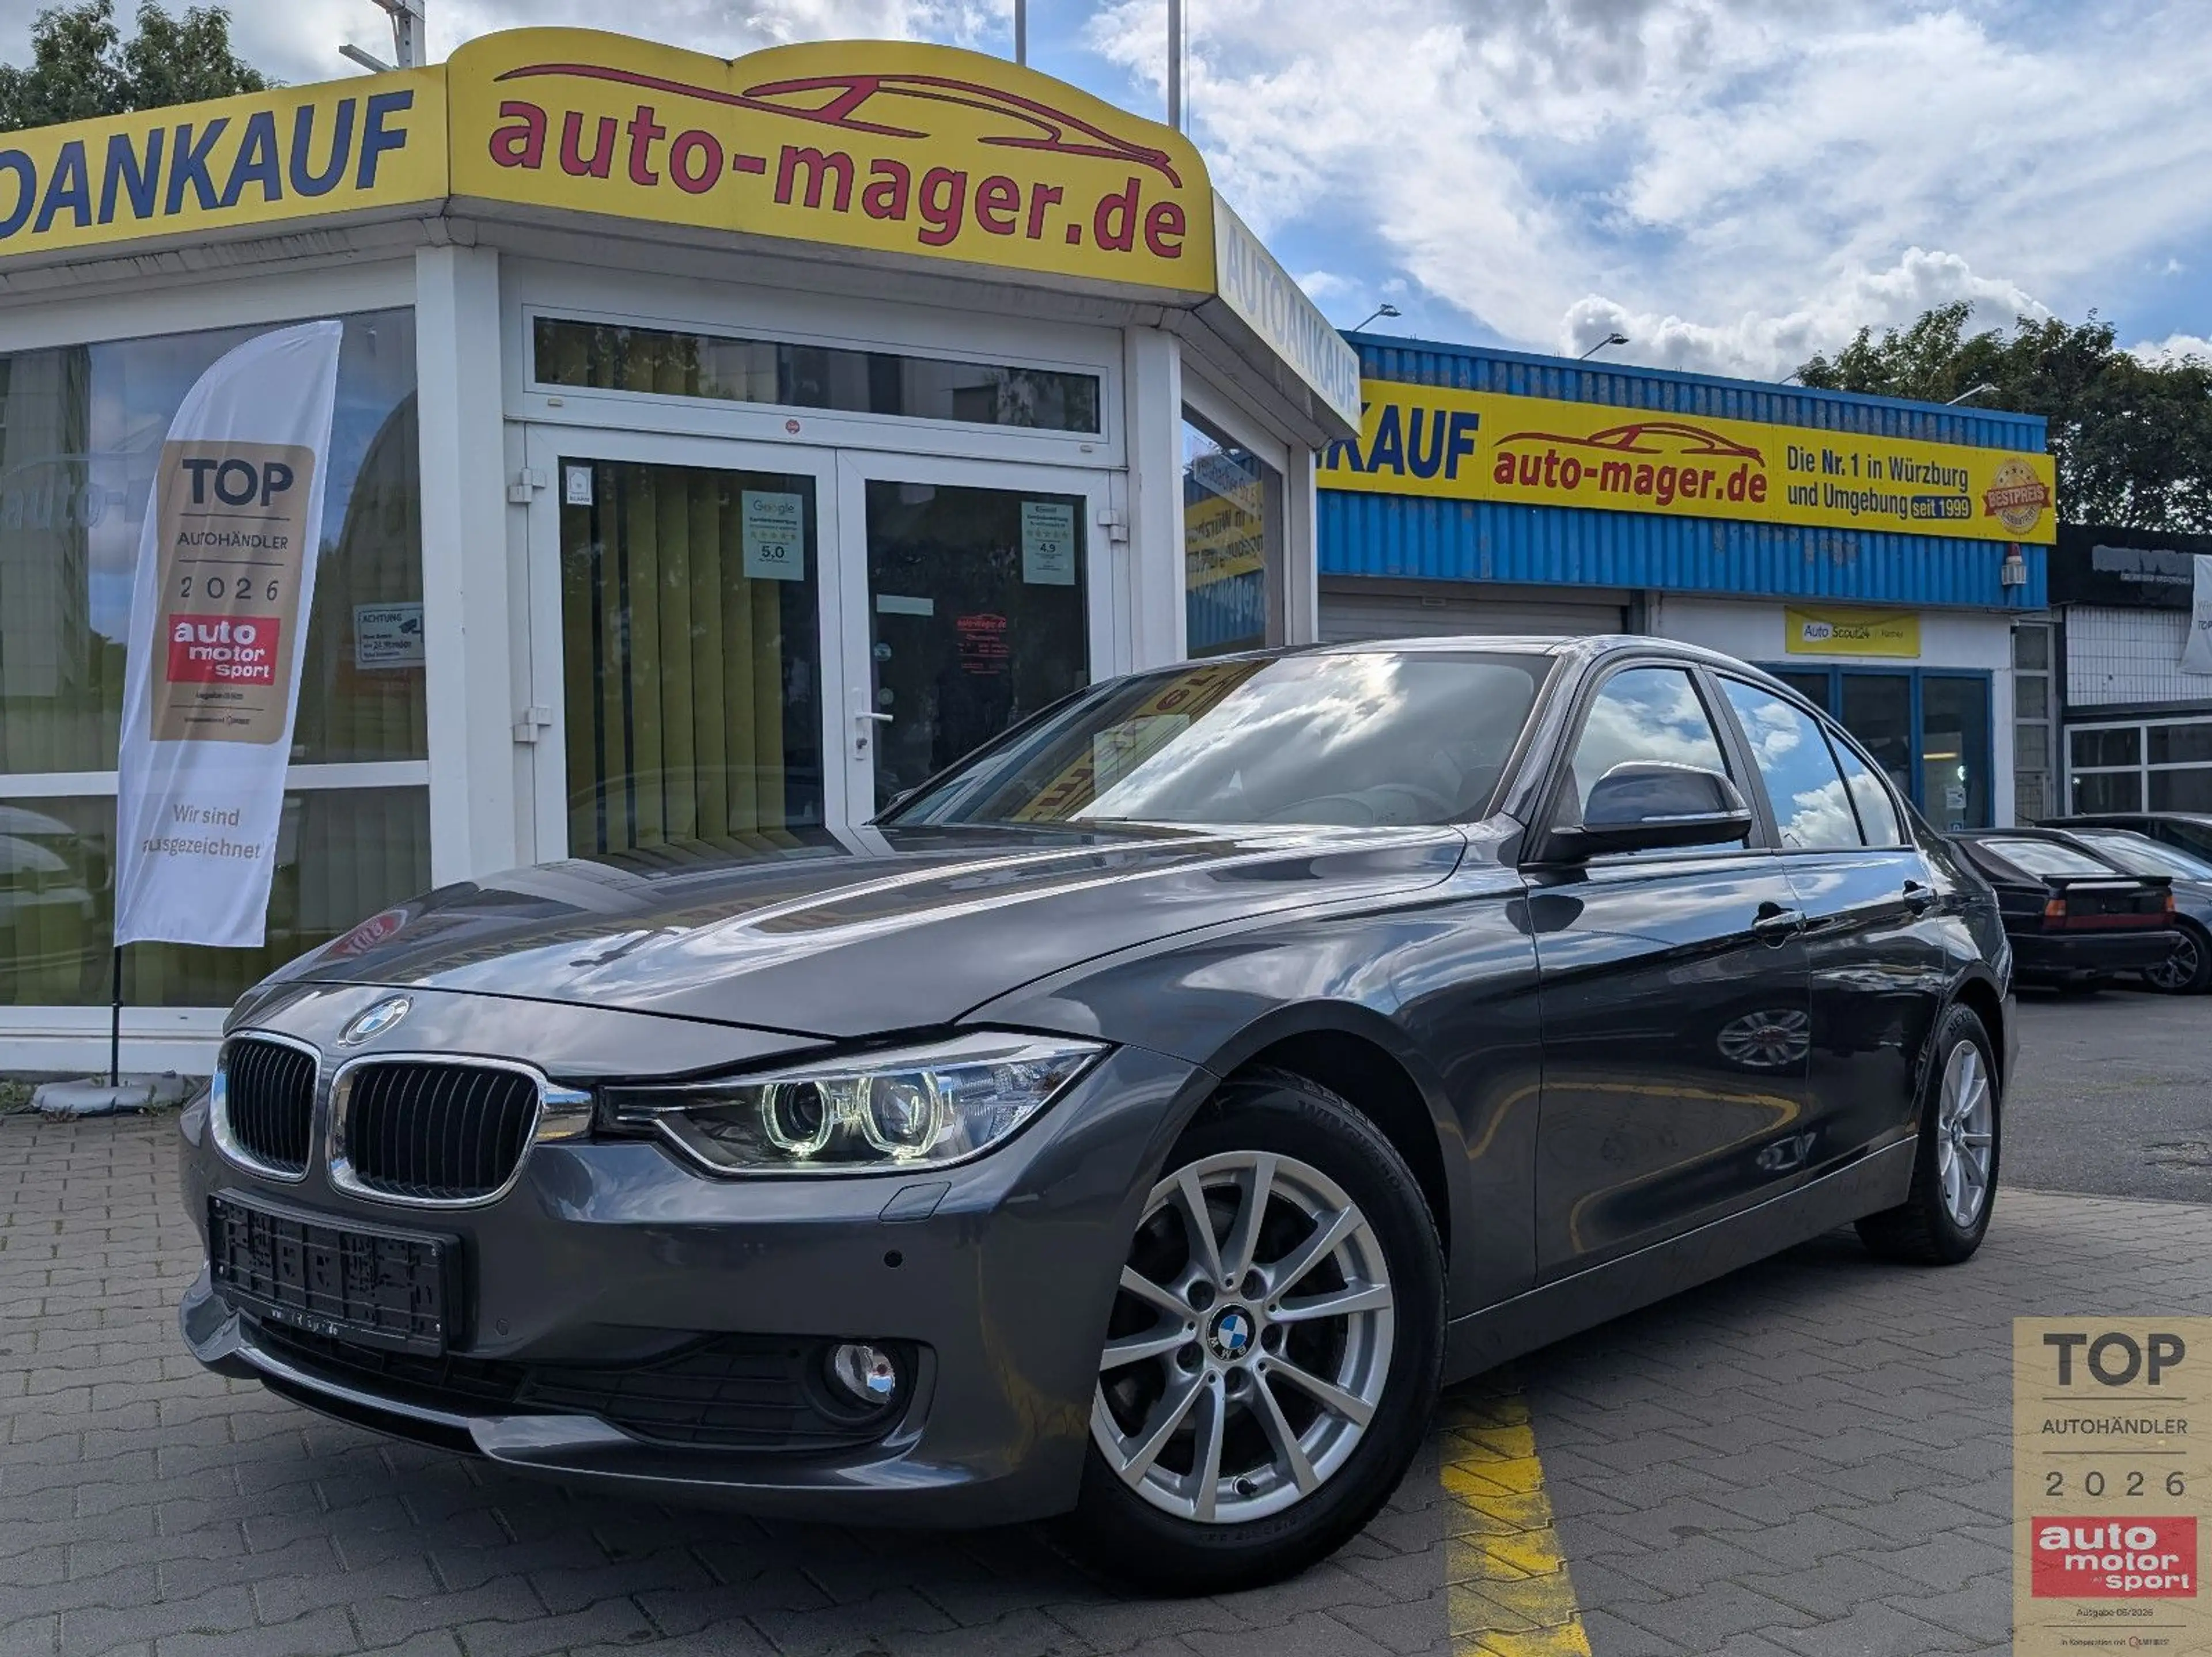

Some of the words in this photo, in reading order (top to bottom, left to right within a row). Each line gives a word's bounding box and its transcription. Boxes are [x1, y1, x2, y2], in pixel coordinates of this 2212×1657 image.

[488, 100, 1187, 259] auto-mager.de
[1225, 225, 1357, 414] AUTOANKAUF
[1316, 403, 1479, 479] KAUF
[1493, 449, 1767, 506] auto-mager.de
[1787, 445, 1815, 472] Die
[1822, 449, 1846, 476] Nr.
[1851, 453, 1858, 477] 1
[1868, 454, 1882, 479] in
[1889, 456, 1968, 493] Würzburg
[183, 459, 293, 506] TOP
[1787, 481, 1818, 506] und
[1824, 483, 1908, 520] Umgebung
[1913, 499, 1937, 516] seit
[1940, 499, 1969, 517] 1999
[1988, 485, 2045, 508] BESTPREIS
[177, 531, 288, 549] AUTOHÄNDLER
[762, 546, 785, 559] 5,0
[181, 576, 279, 601] 2026
[174, 620, 256, 644] auto
[1804, 625, 1828, 638] Auto
[189, 646, 265, 662] motor
[215, 664, 270, 678] sport
[173, 804, 199, 824] Wir
[202, 807, 240, 826] sind
